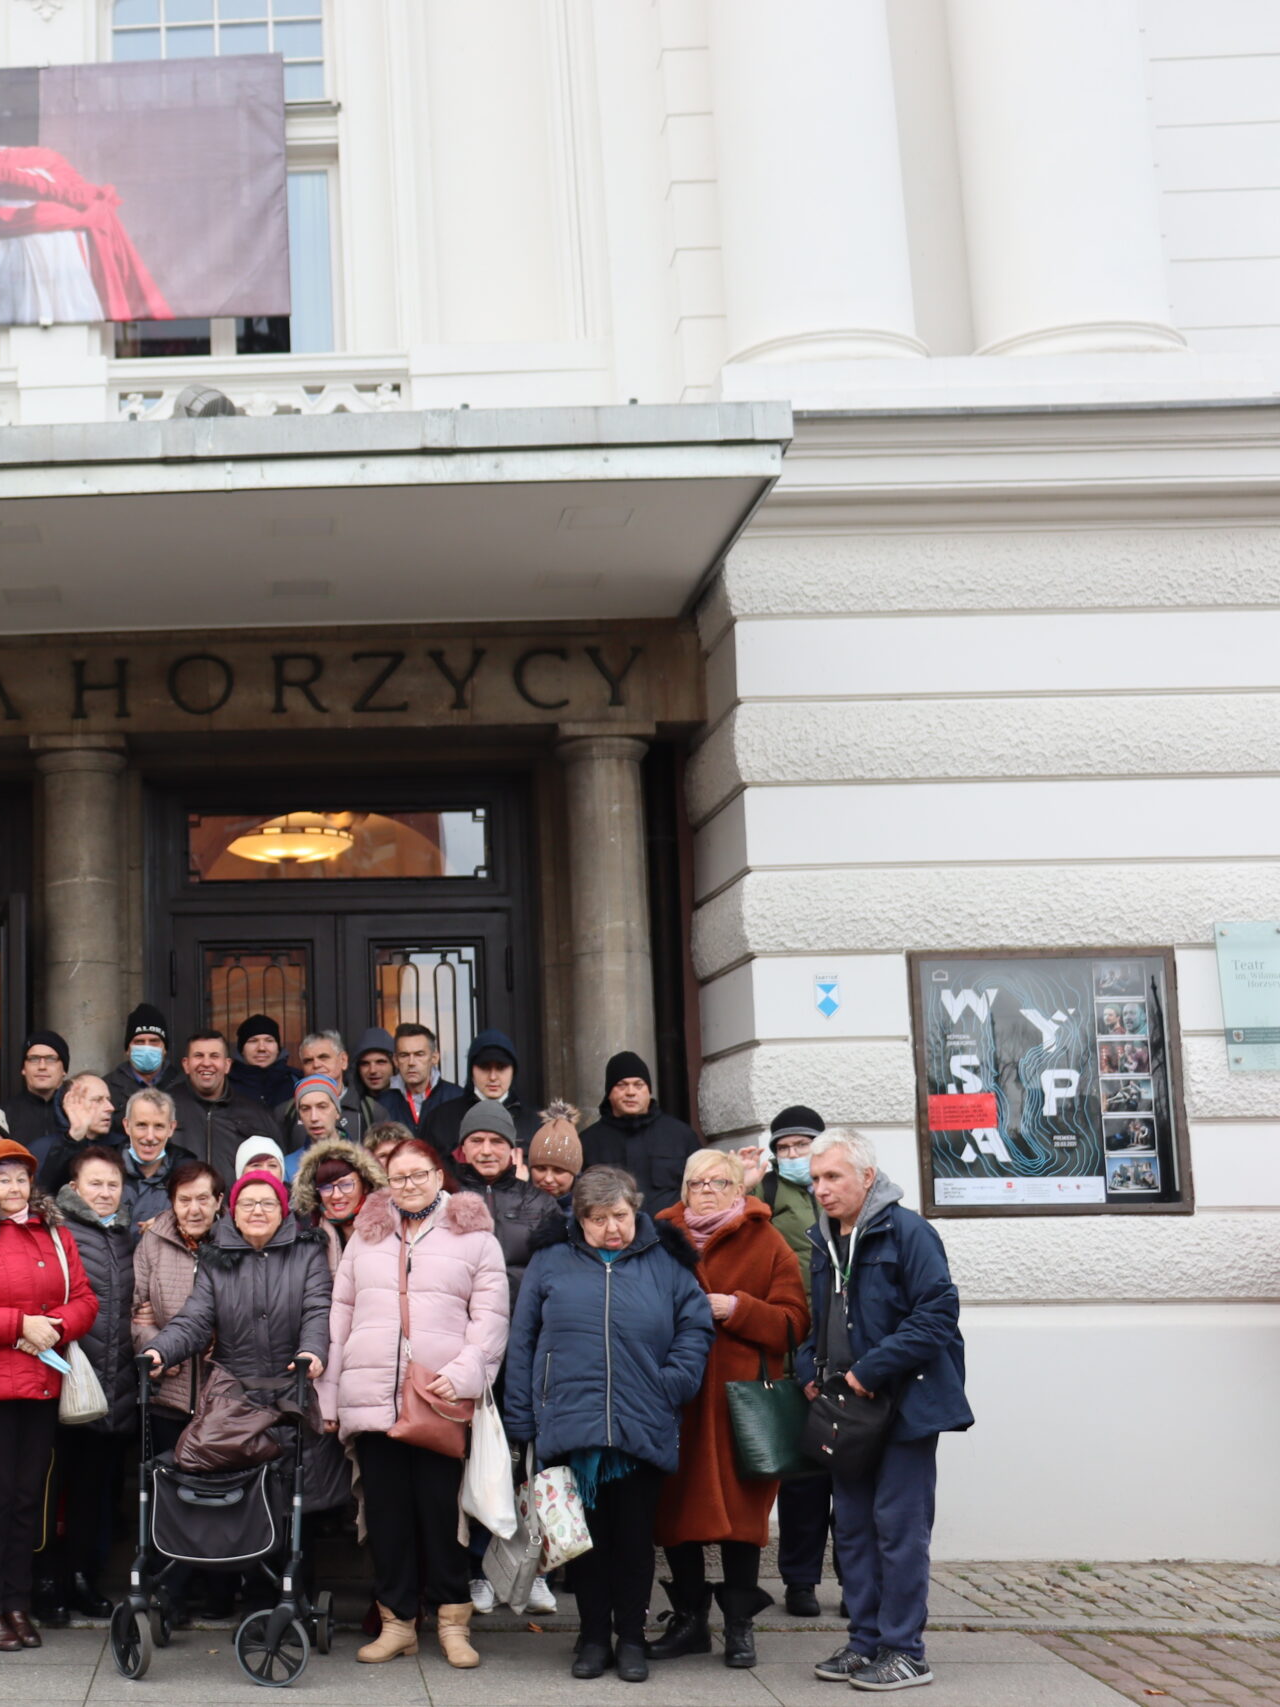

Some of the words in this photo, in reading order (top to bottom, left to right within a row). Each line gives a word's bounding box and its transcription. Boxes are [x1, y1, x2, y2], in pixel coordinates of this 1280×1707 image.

[72, 646, 645, 720] HORZYCY
[1232, 960, 1264, 970] Teatr
[941, 988, 999, 1025] W
[1040, 1068, 1081, 1116] P
[960, 1127, 1013, 1162] A
